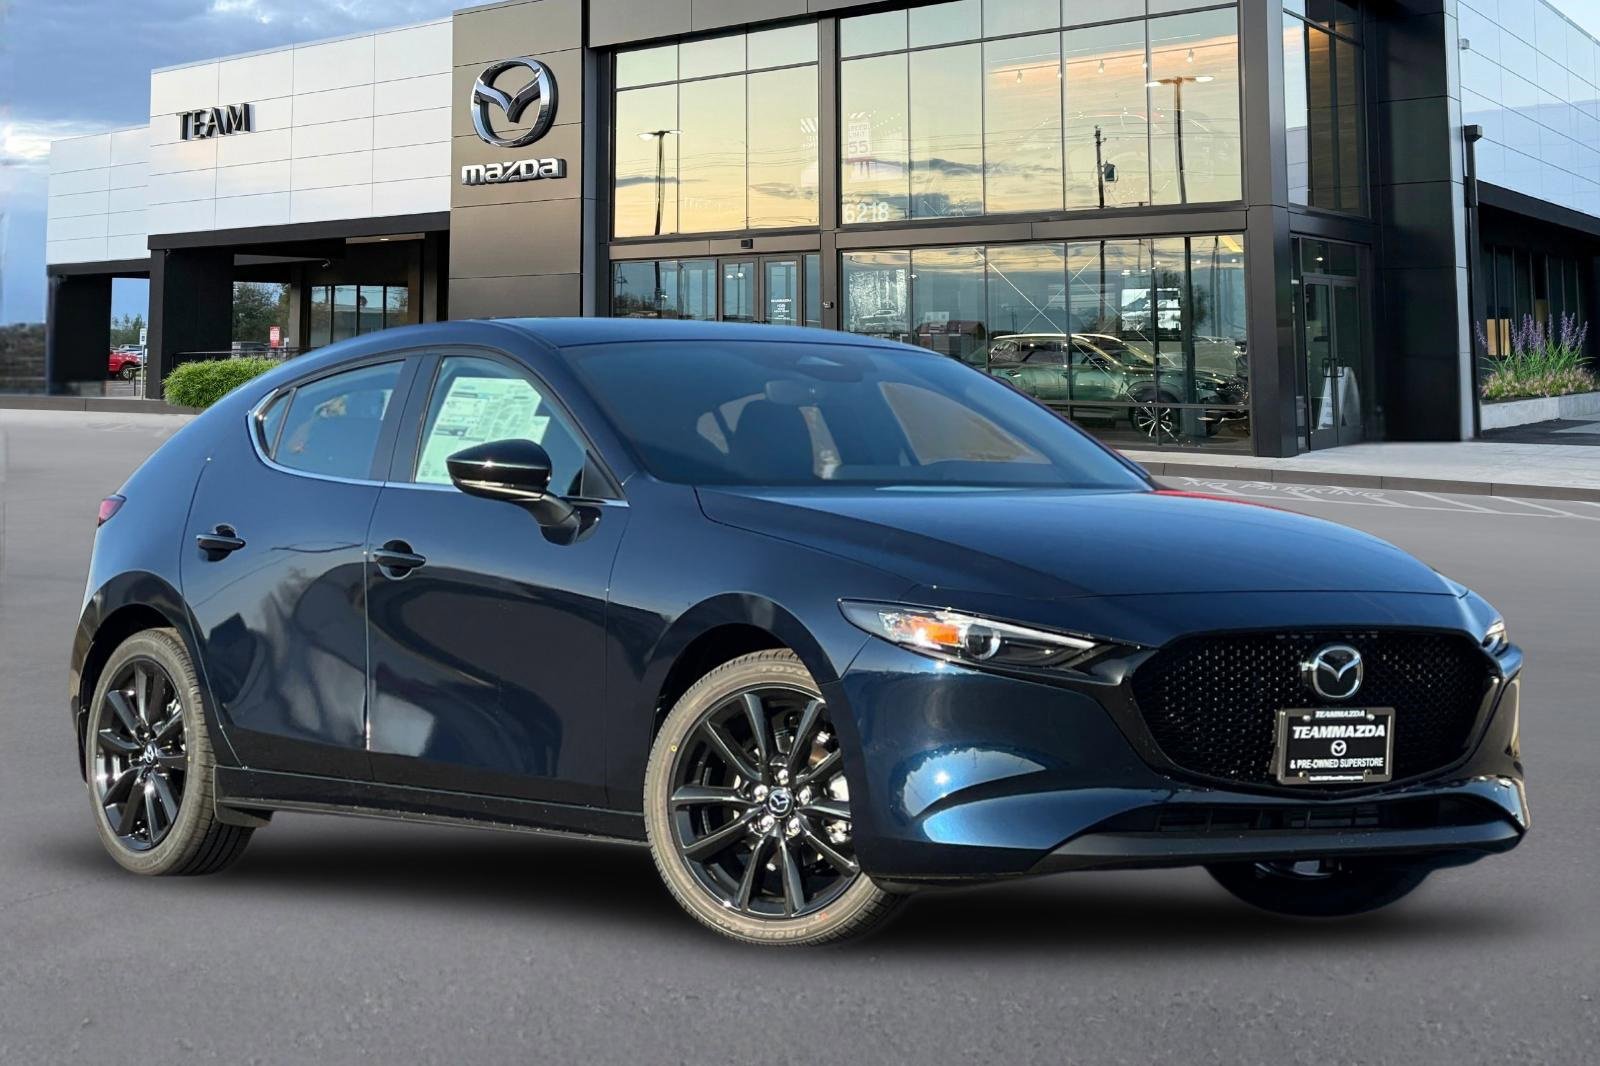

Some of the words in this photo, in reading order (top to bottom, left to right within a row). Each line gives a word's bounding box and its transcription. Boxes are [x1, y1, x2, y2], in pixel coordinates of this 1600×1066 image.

[176, 103, 251, 140] TEAM
[1315, 710, 1365, 718] TEAMMAZDA
[1292, 724, 1386, 739] TEAMMAZDA
[1290, 759, 1296, 769] &
[1297, 758, 1339, 769] PRE-OWNED
[1340, 757, 1384, 768] SUPERSTORE
